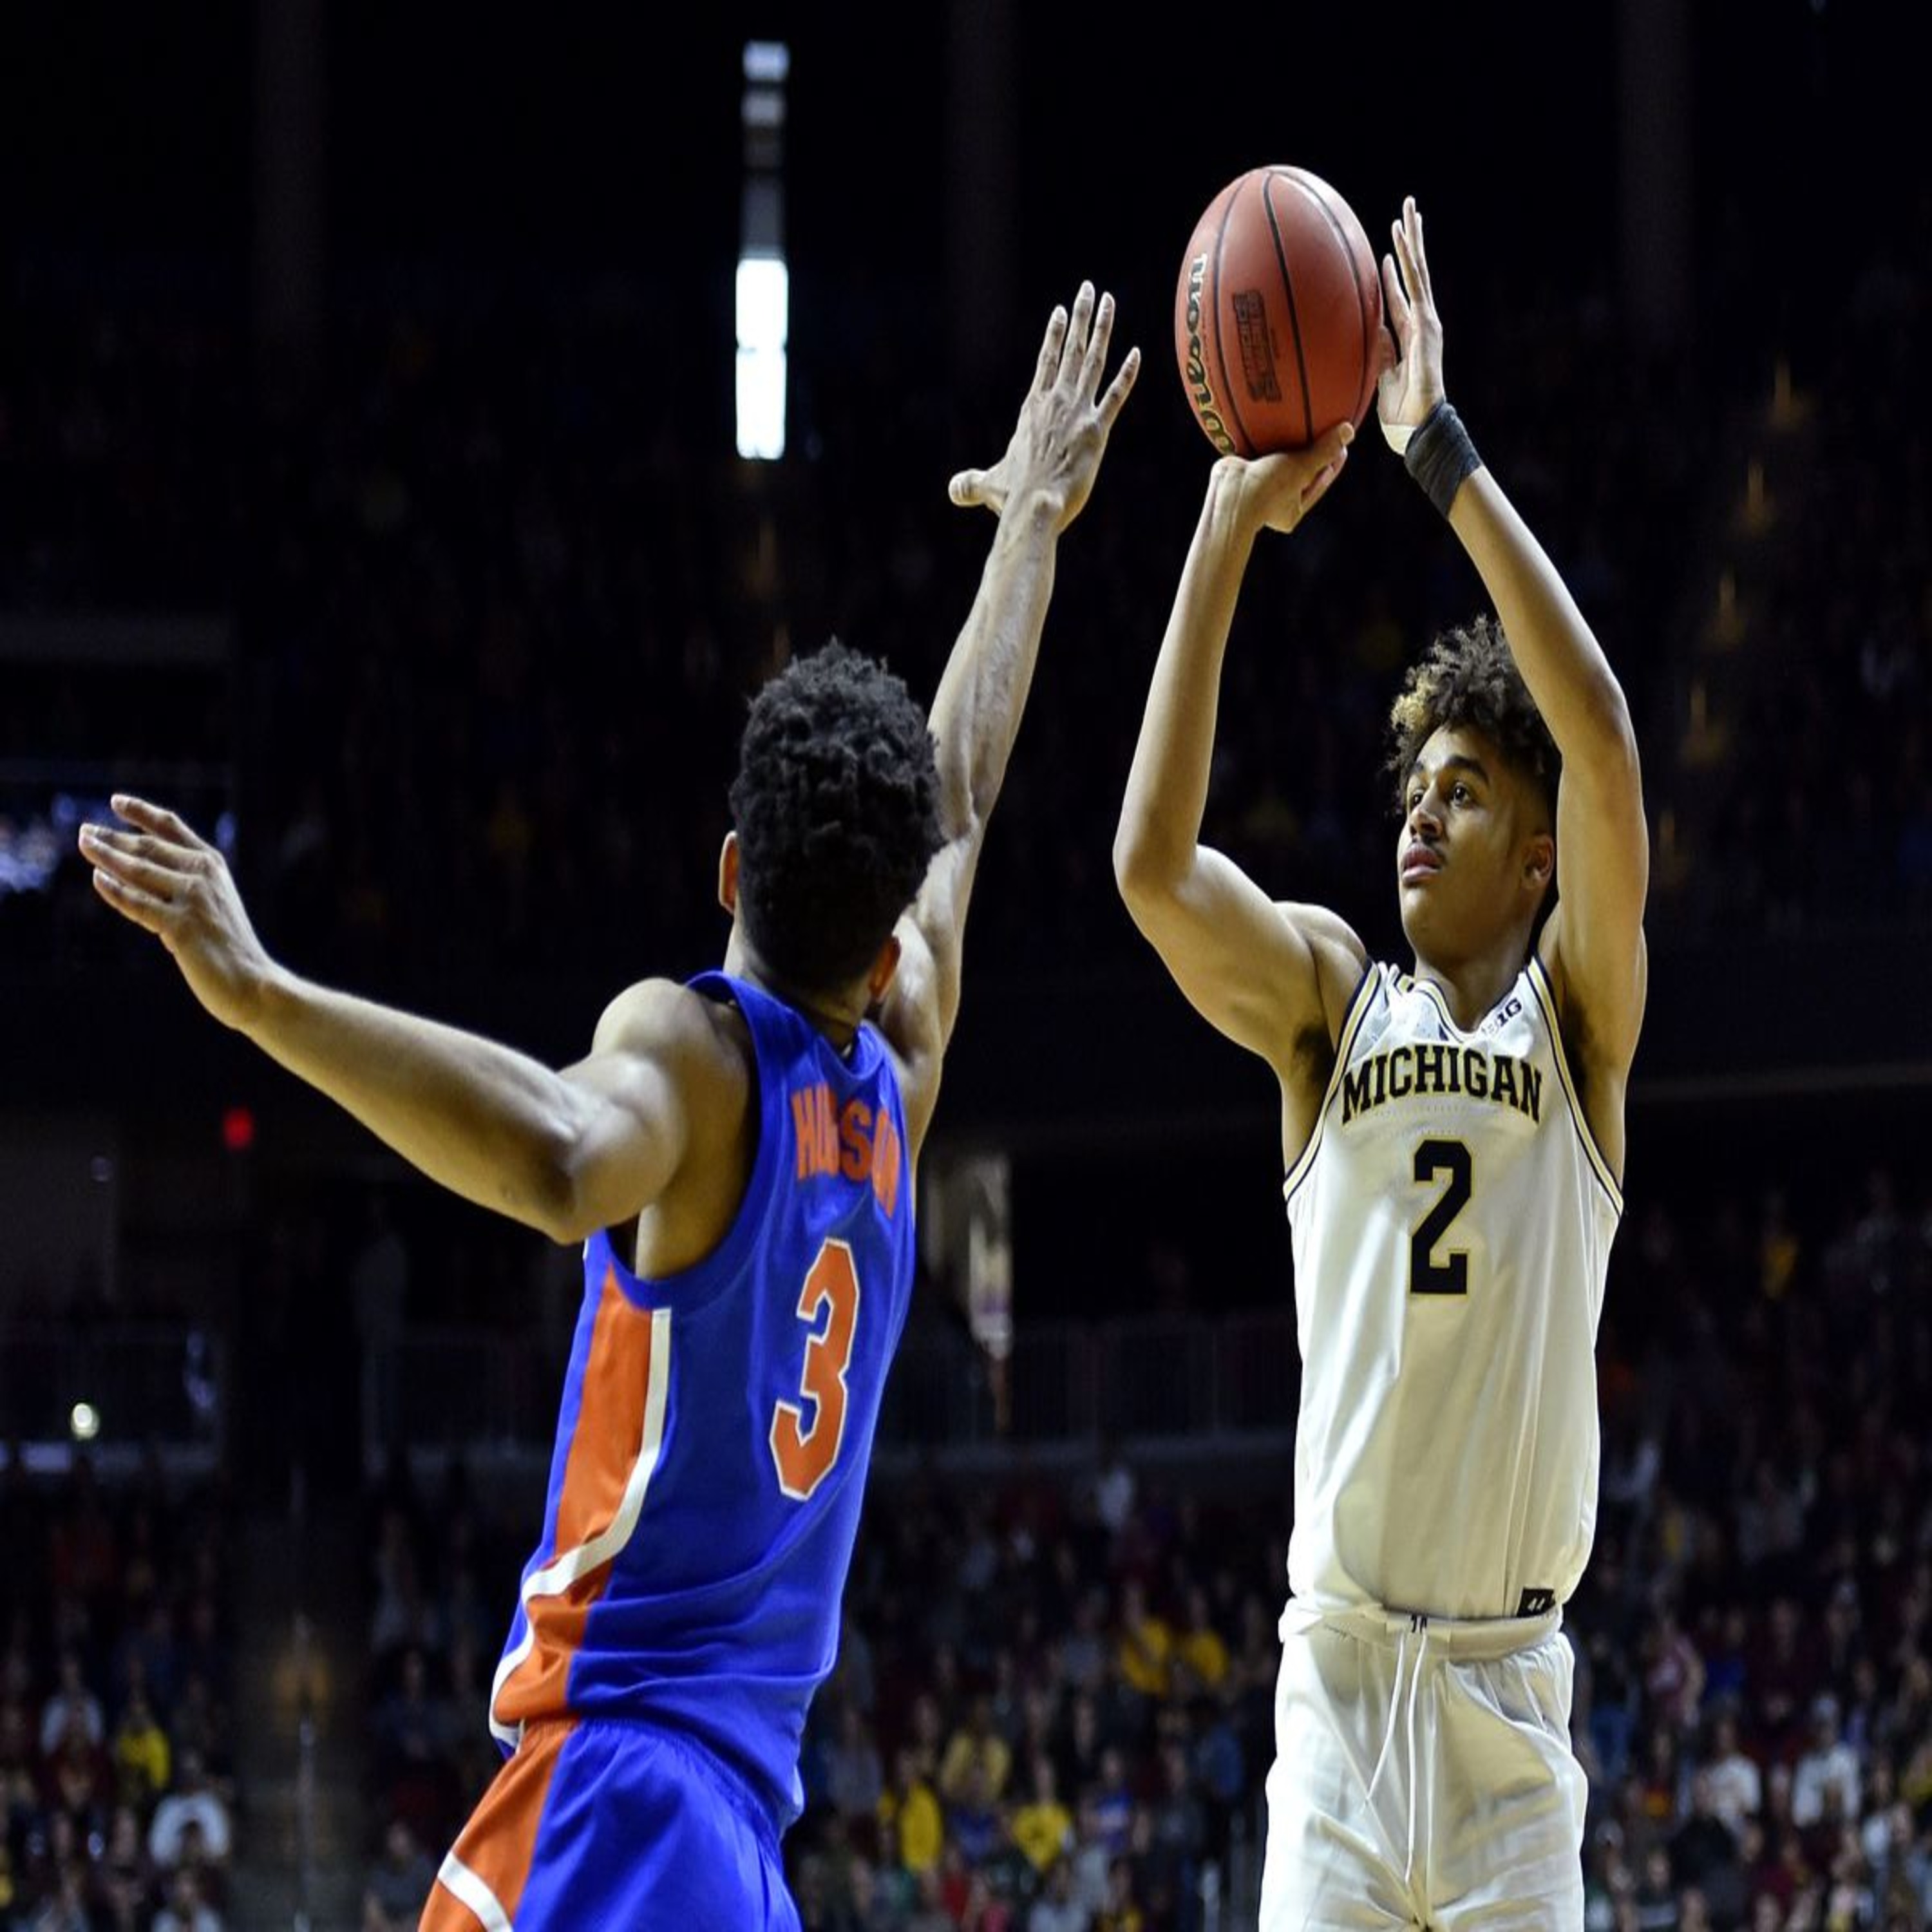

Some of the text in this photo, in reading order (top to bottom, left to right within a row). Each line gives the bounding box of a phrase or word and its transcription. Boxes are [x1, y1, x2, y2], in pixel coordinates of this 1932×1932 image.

[1341, 1043, 1543, 1127] MICHIGAN
[1410, 1139, 1472, 1294] 2
[769, 1237, 860, 1501] 3
